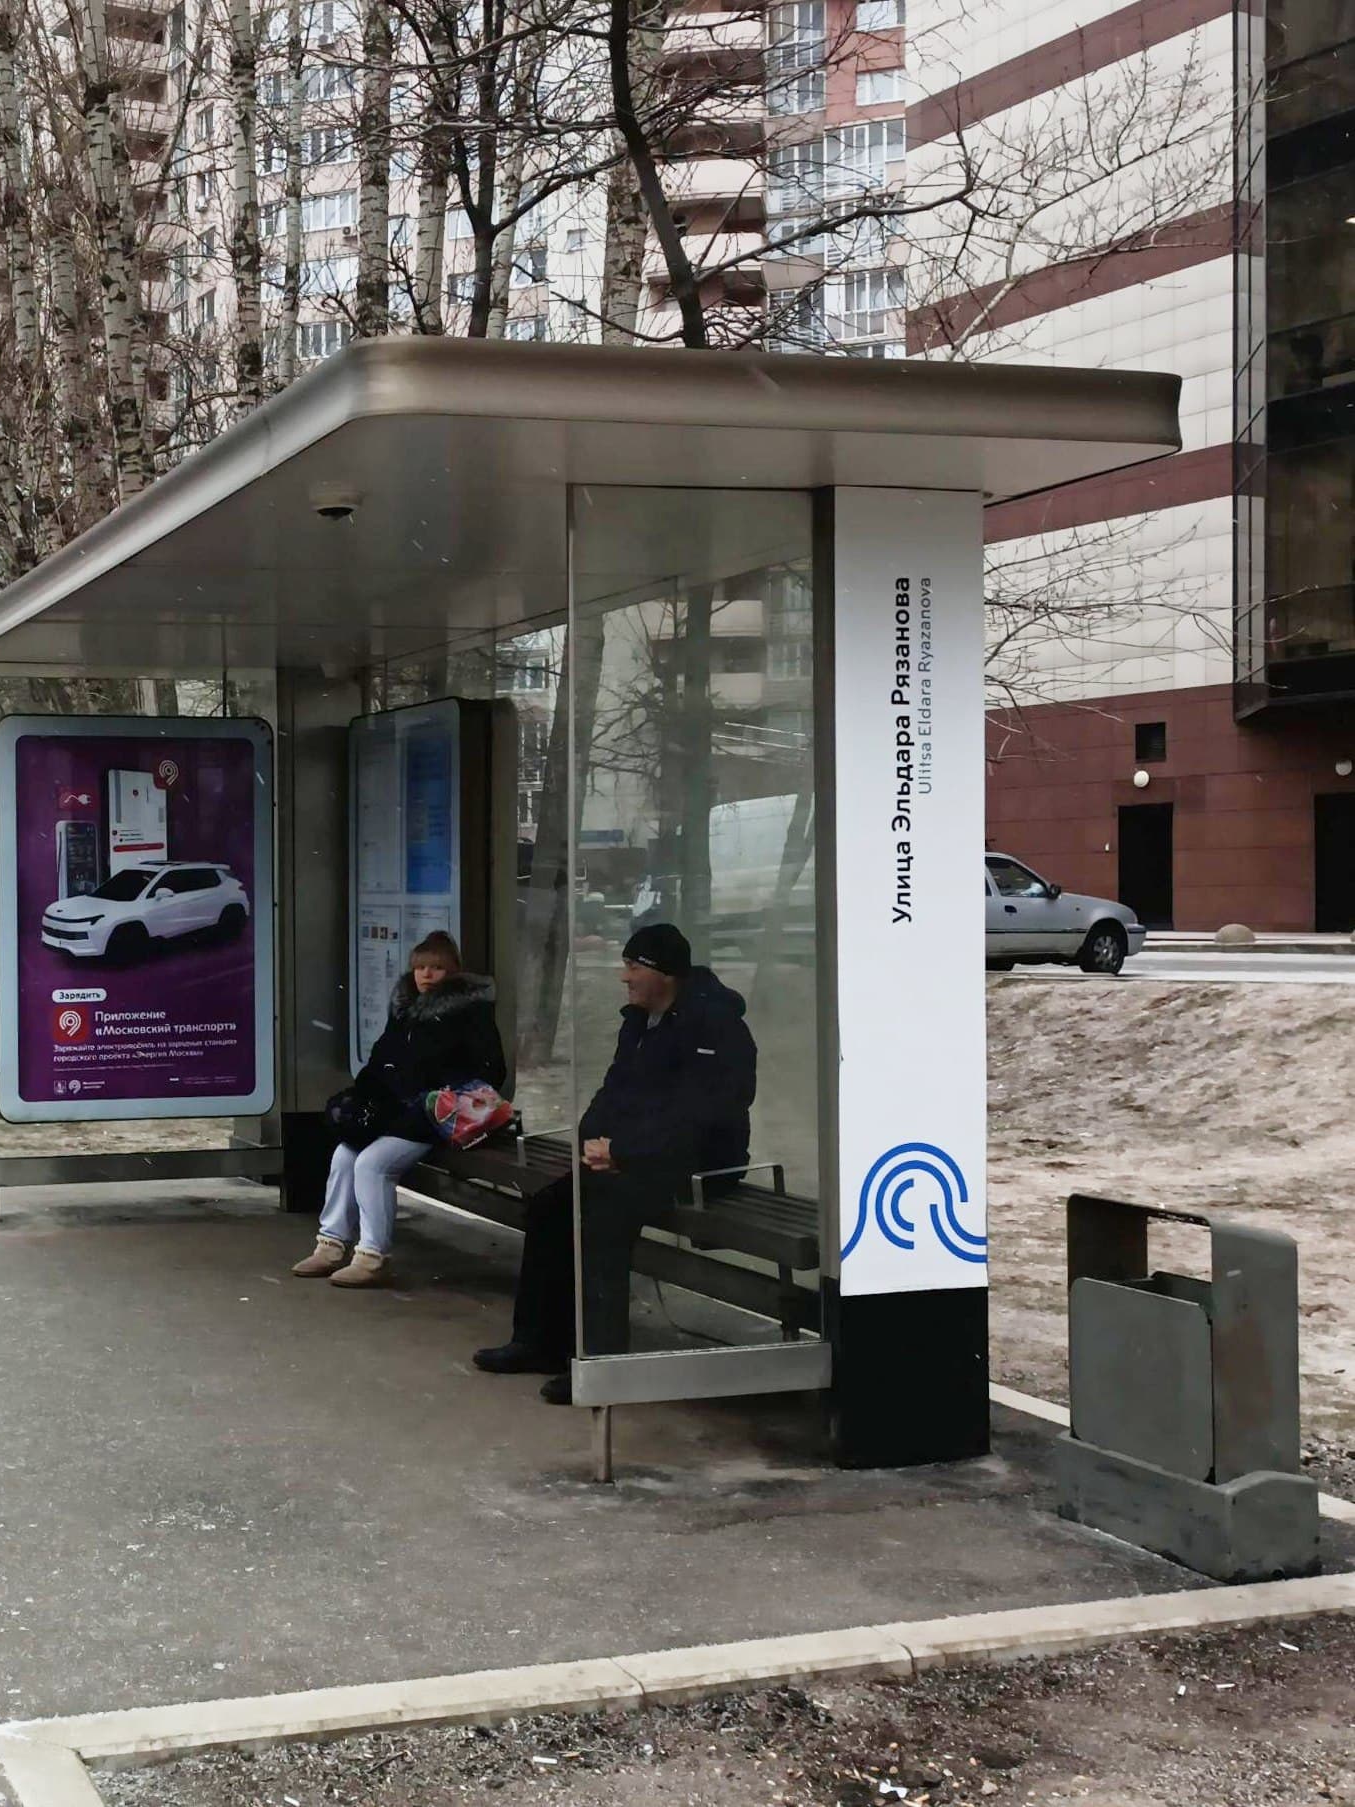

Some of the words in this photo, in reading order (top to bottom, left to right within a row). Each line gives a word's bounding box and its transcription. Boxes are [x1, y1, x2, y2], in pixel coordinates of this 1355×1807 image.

[891, 577, 911, 705] Рязанова
[917, 577, 934, 672] Ryazanova
[918, 678, 932, 736] Eldara
[891, 715, 915, 831] Эльдара
[918, 742, 932, 794] Ulitsa
[892, 840, 914, 923] Улица
[59, 991, 102, 1001] Зарядить
[95, 1010, 166, 1023] Приложение
[95, 1023, 172, 1036] «Московский
[174, 1022, 237, 1034] транспорт»
